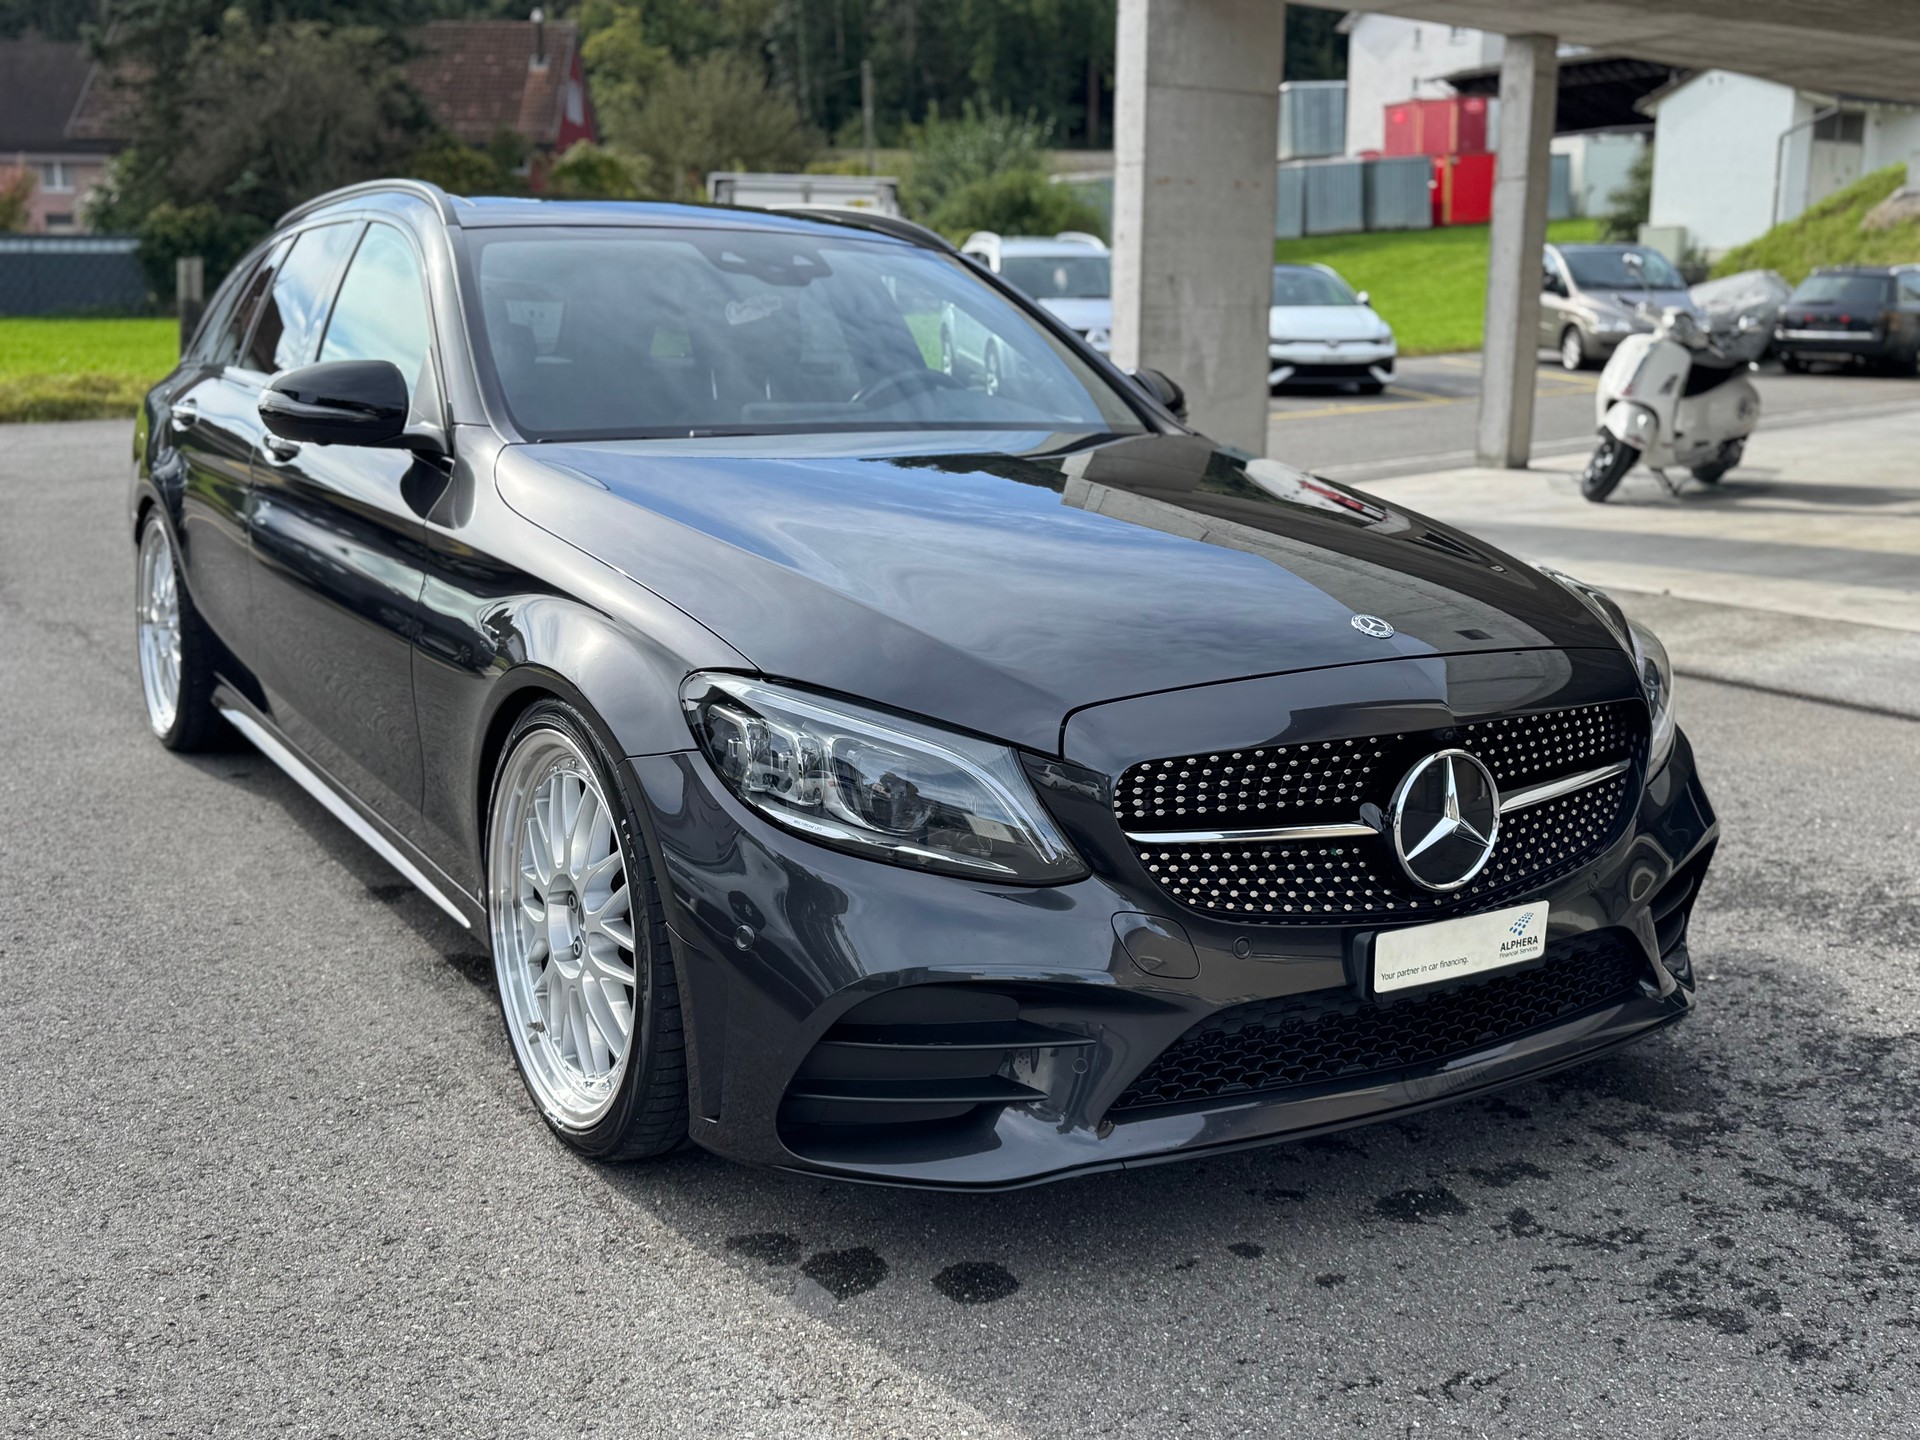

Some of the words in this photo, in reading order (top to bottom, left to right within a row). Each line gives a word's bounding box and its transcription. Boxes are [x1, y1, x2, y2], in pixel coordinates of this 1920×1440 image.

[1499, 949, 1519, 959] Financial
[1519, 945, 1538, 954] Services
[1500, 935, 1538, 952] ALPHERA
[1381, 972, 1396, 981] Your
[1397, 967, 1420, 979] partner
[1421, 964, 1427, 972] in
[1428, 962, 1438, 970] car
[1439, 956, 1469, 969] financing.
